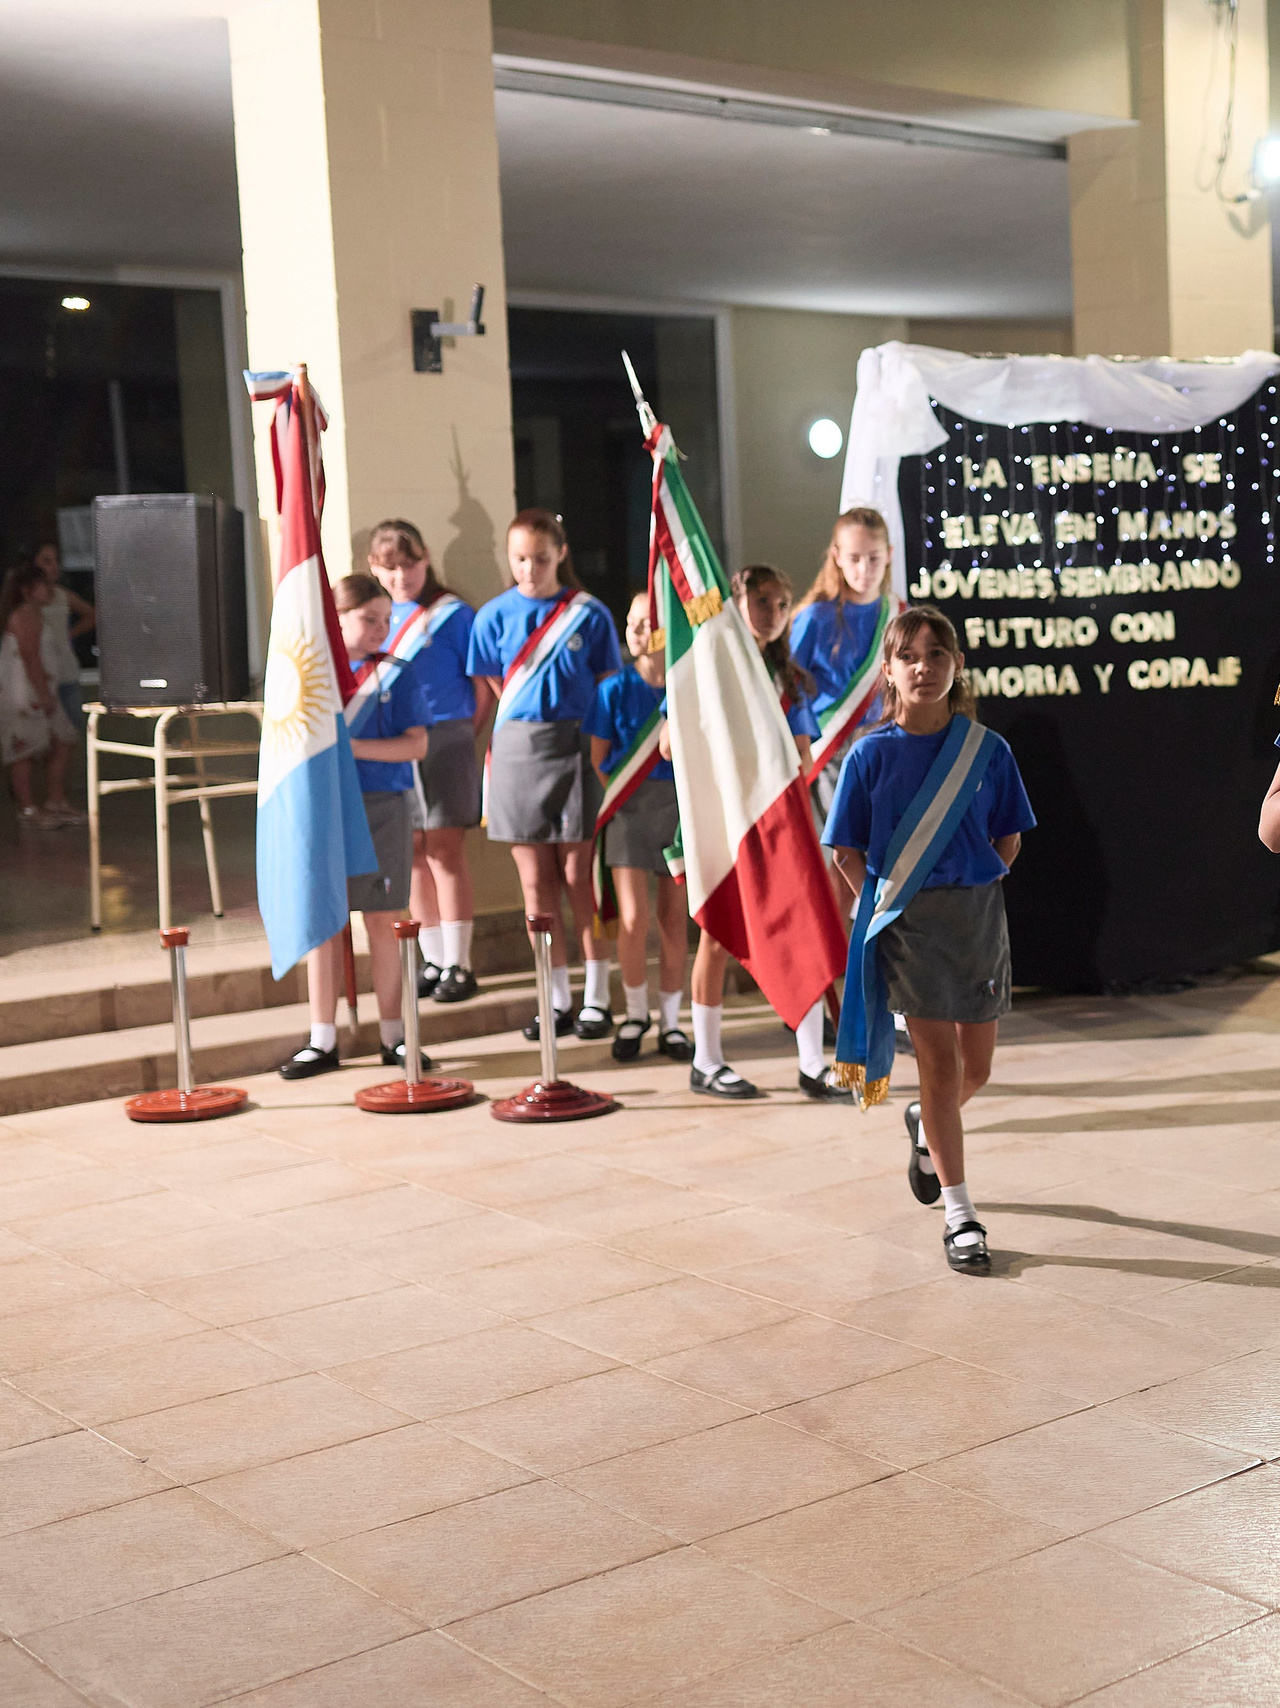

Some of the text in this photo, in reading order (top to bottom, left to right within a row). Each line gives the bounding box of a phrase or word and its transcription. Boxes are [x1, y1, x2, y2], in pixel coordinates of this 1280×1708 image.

[961, 446, 1222, 489] LA ENSEÑA SE
[942, 509, 1238, 549] ELEVA EN MANOS
[1059, 557, 1242, 599] SEMBRANDO
[964, 609, 1176, 649] FUTURO CON
[963, 656, 1243, 698] MORIA Y CORAJE
